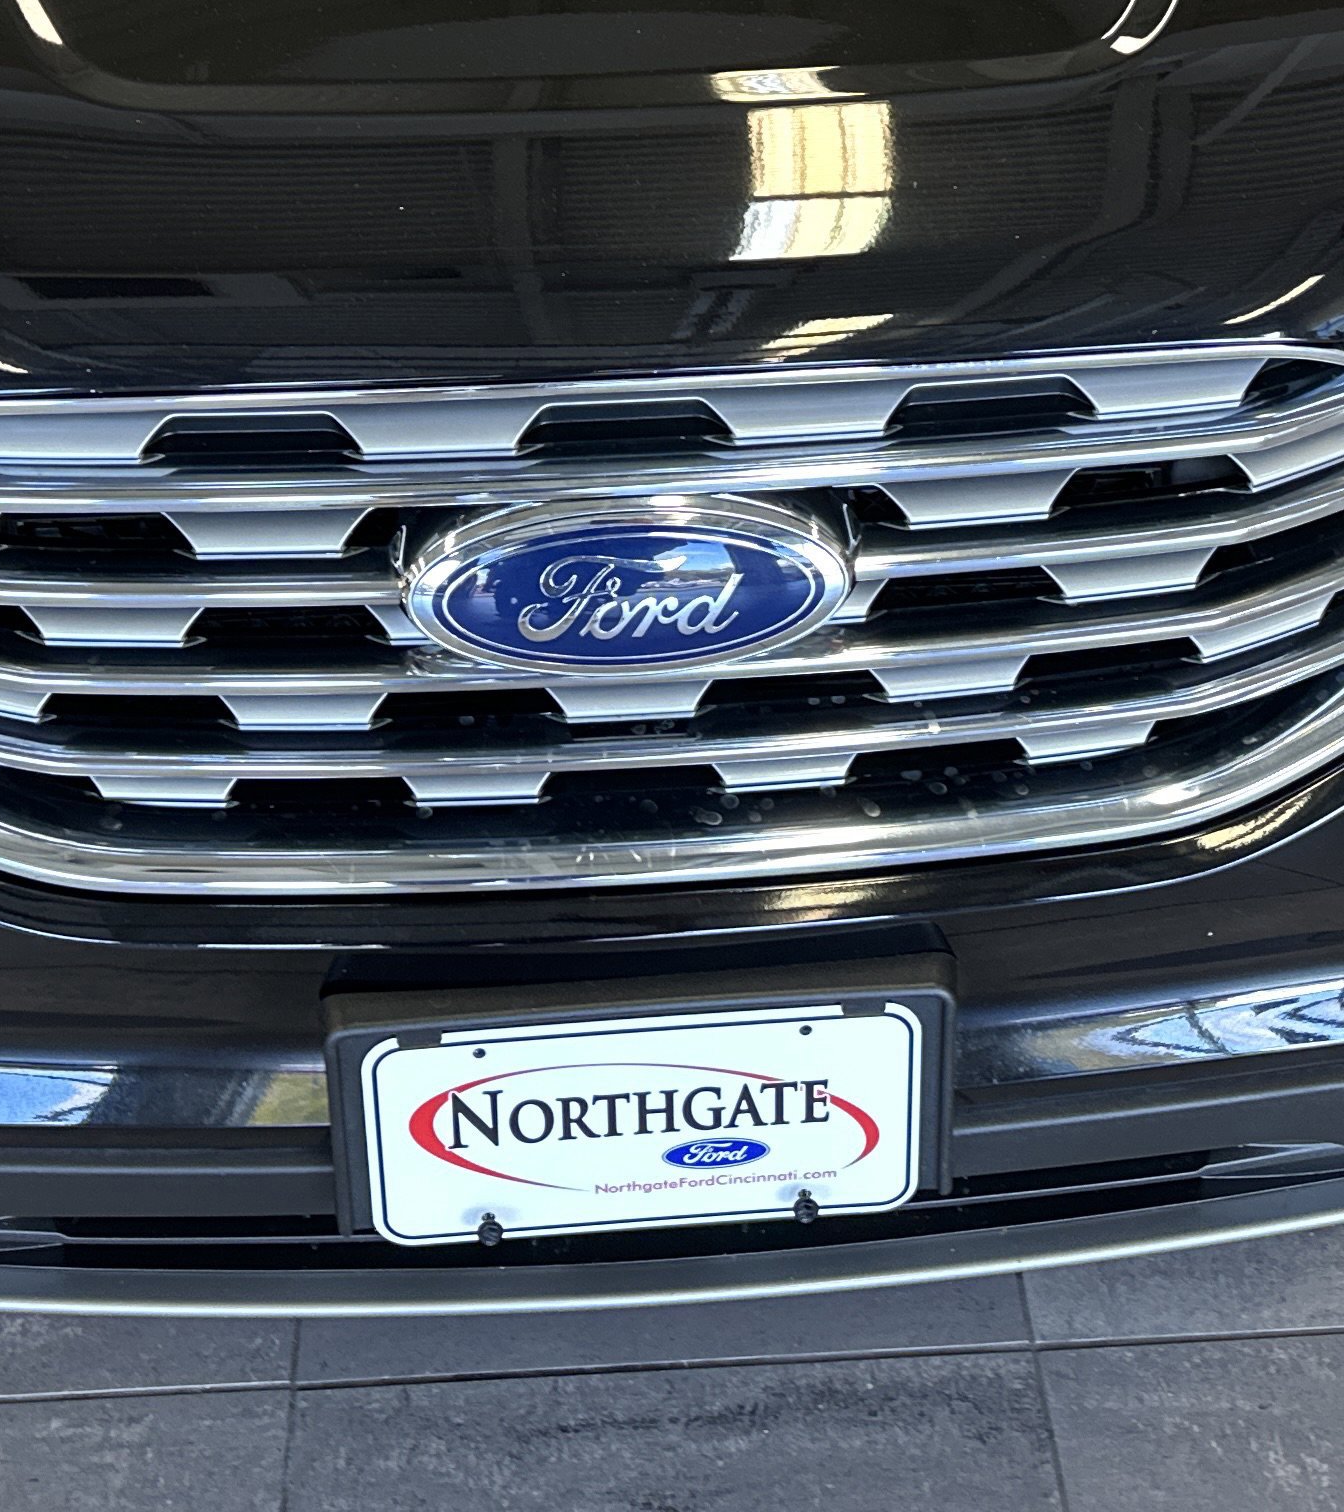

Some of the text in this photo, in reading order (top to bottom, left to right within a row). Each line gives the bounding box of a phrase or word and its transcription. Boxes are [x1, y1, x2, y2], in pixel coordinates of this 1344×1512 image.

[517, 554, 744, 642] Ford
[448, 1079, 830, 1150] NORTHGATE
[682, 1141, 749, 1165] Ford
[594, 1169, 838, 1195] NorthgateFordCincinnati.com
